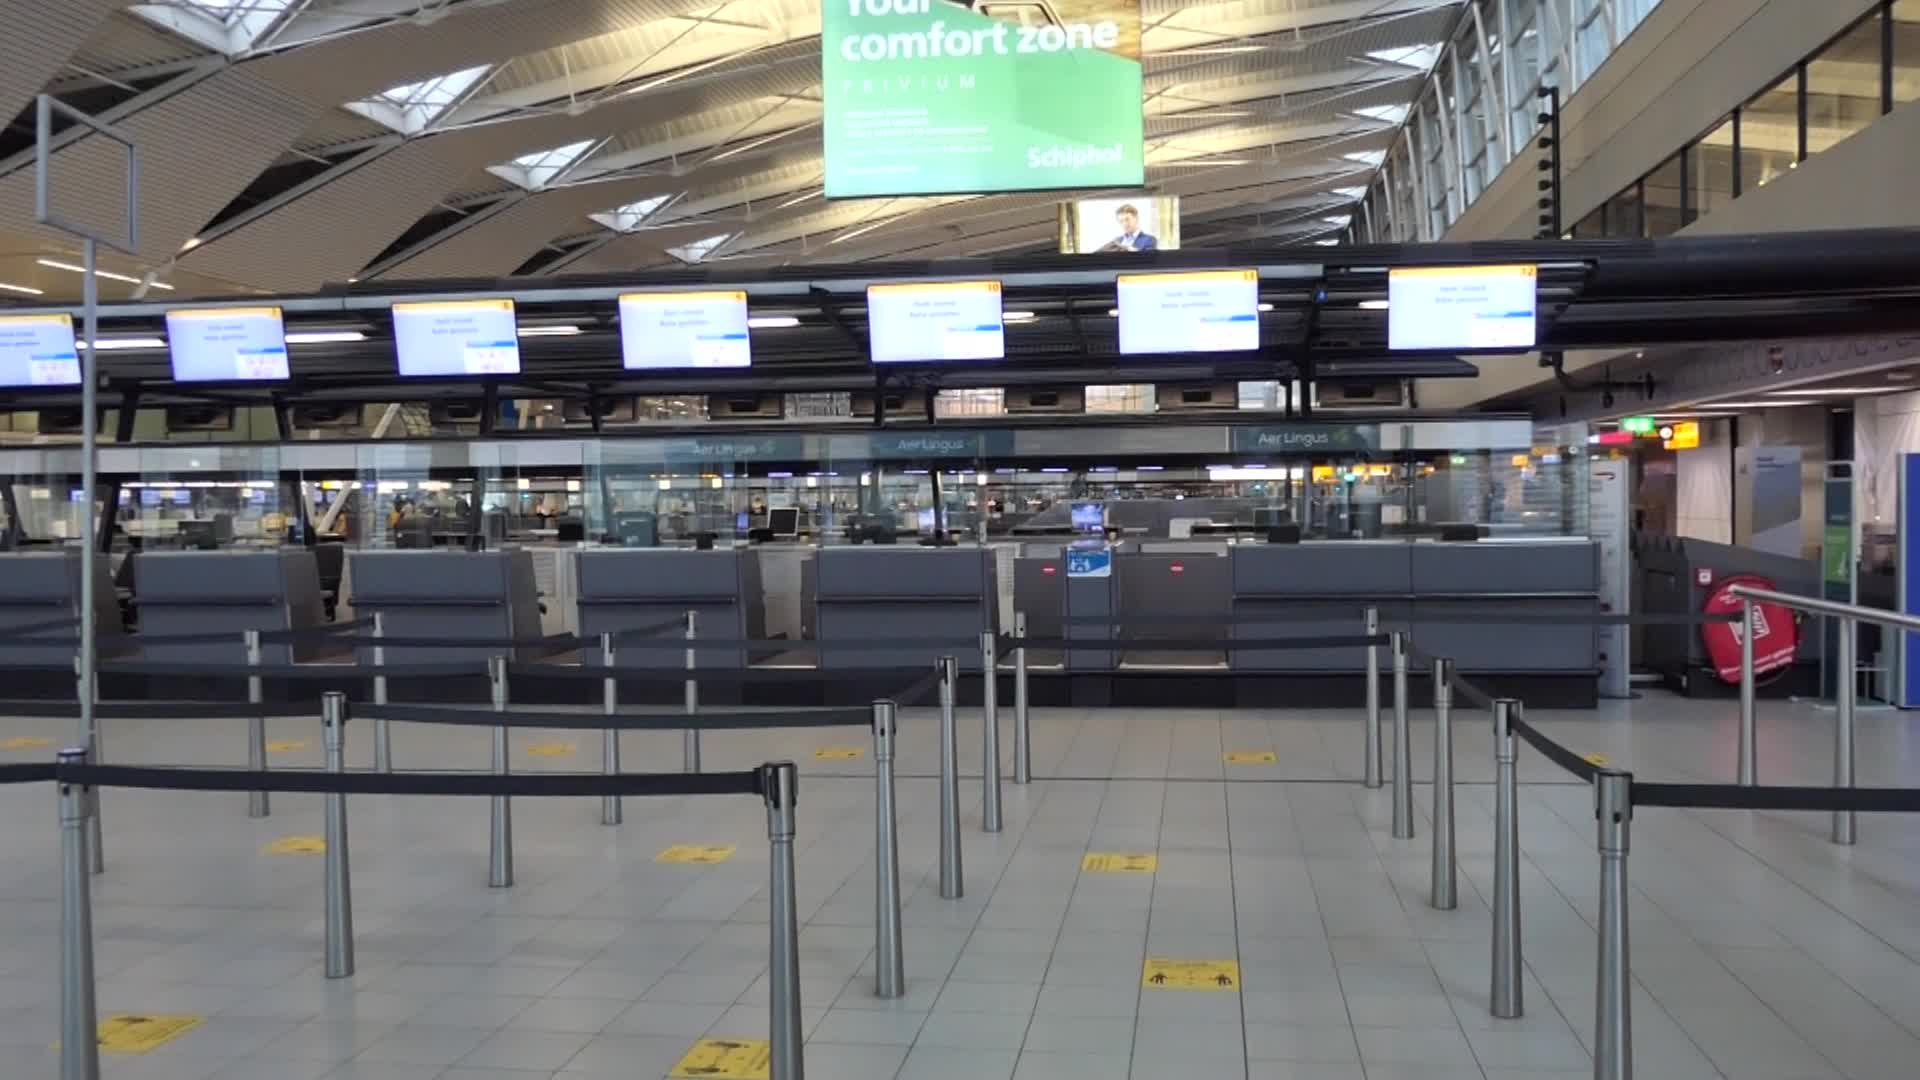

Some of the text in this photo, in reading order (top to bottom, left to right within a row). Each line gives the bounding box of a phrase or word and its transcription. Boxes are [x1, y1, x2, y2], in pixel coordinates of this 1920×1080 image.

[840, 19, 1120, 61] comfort zone
[1027, 143, 1122, 169] Schiphol
